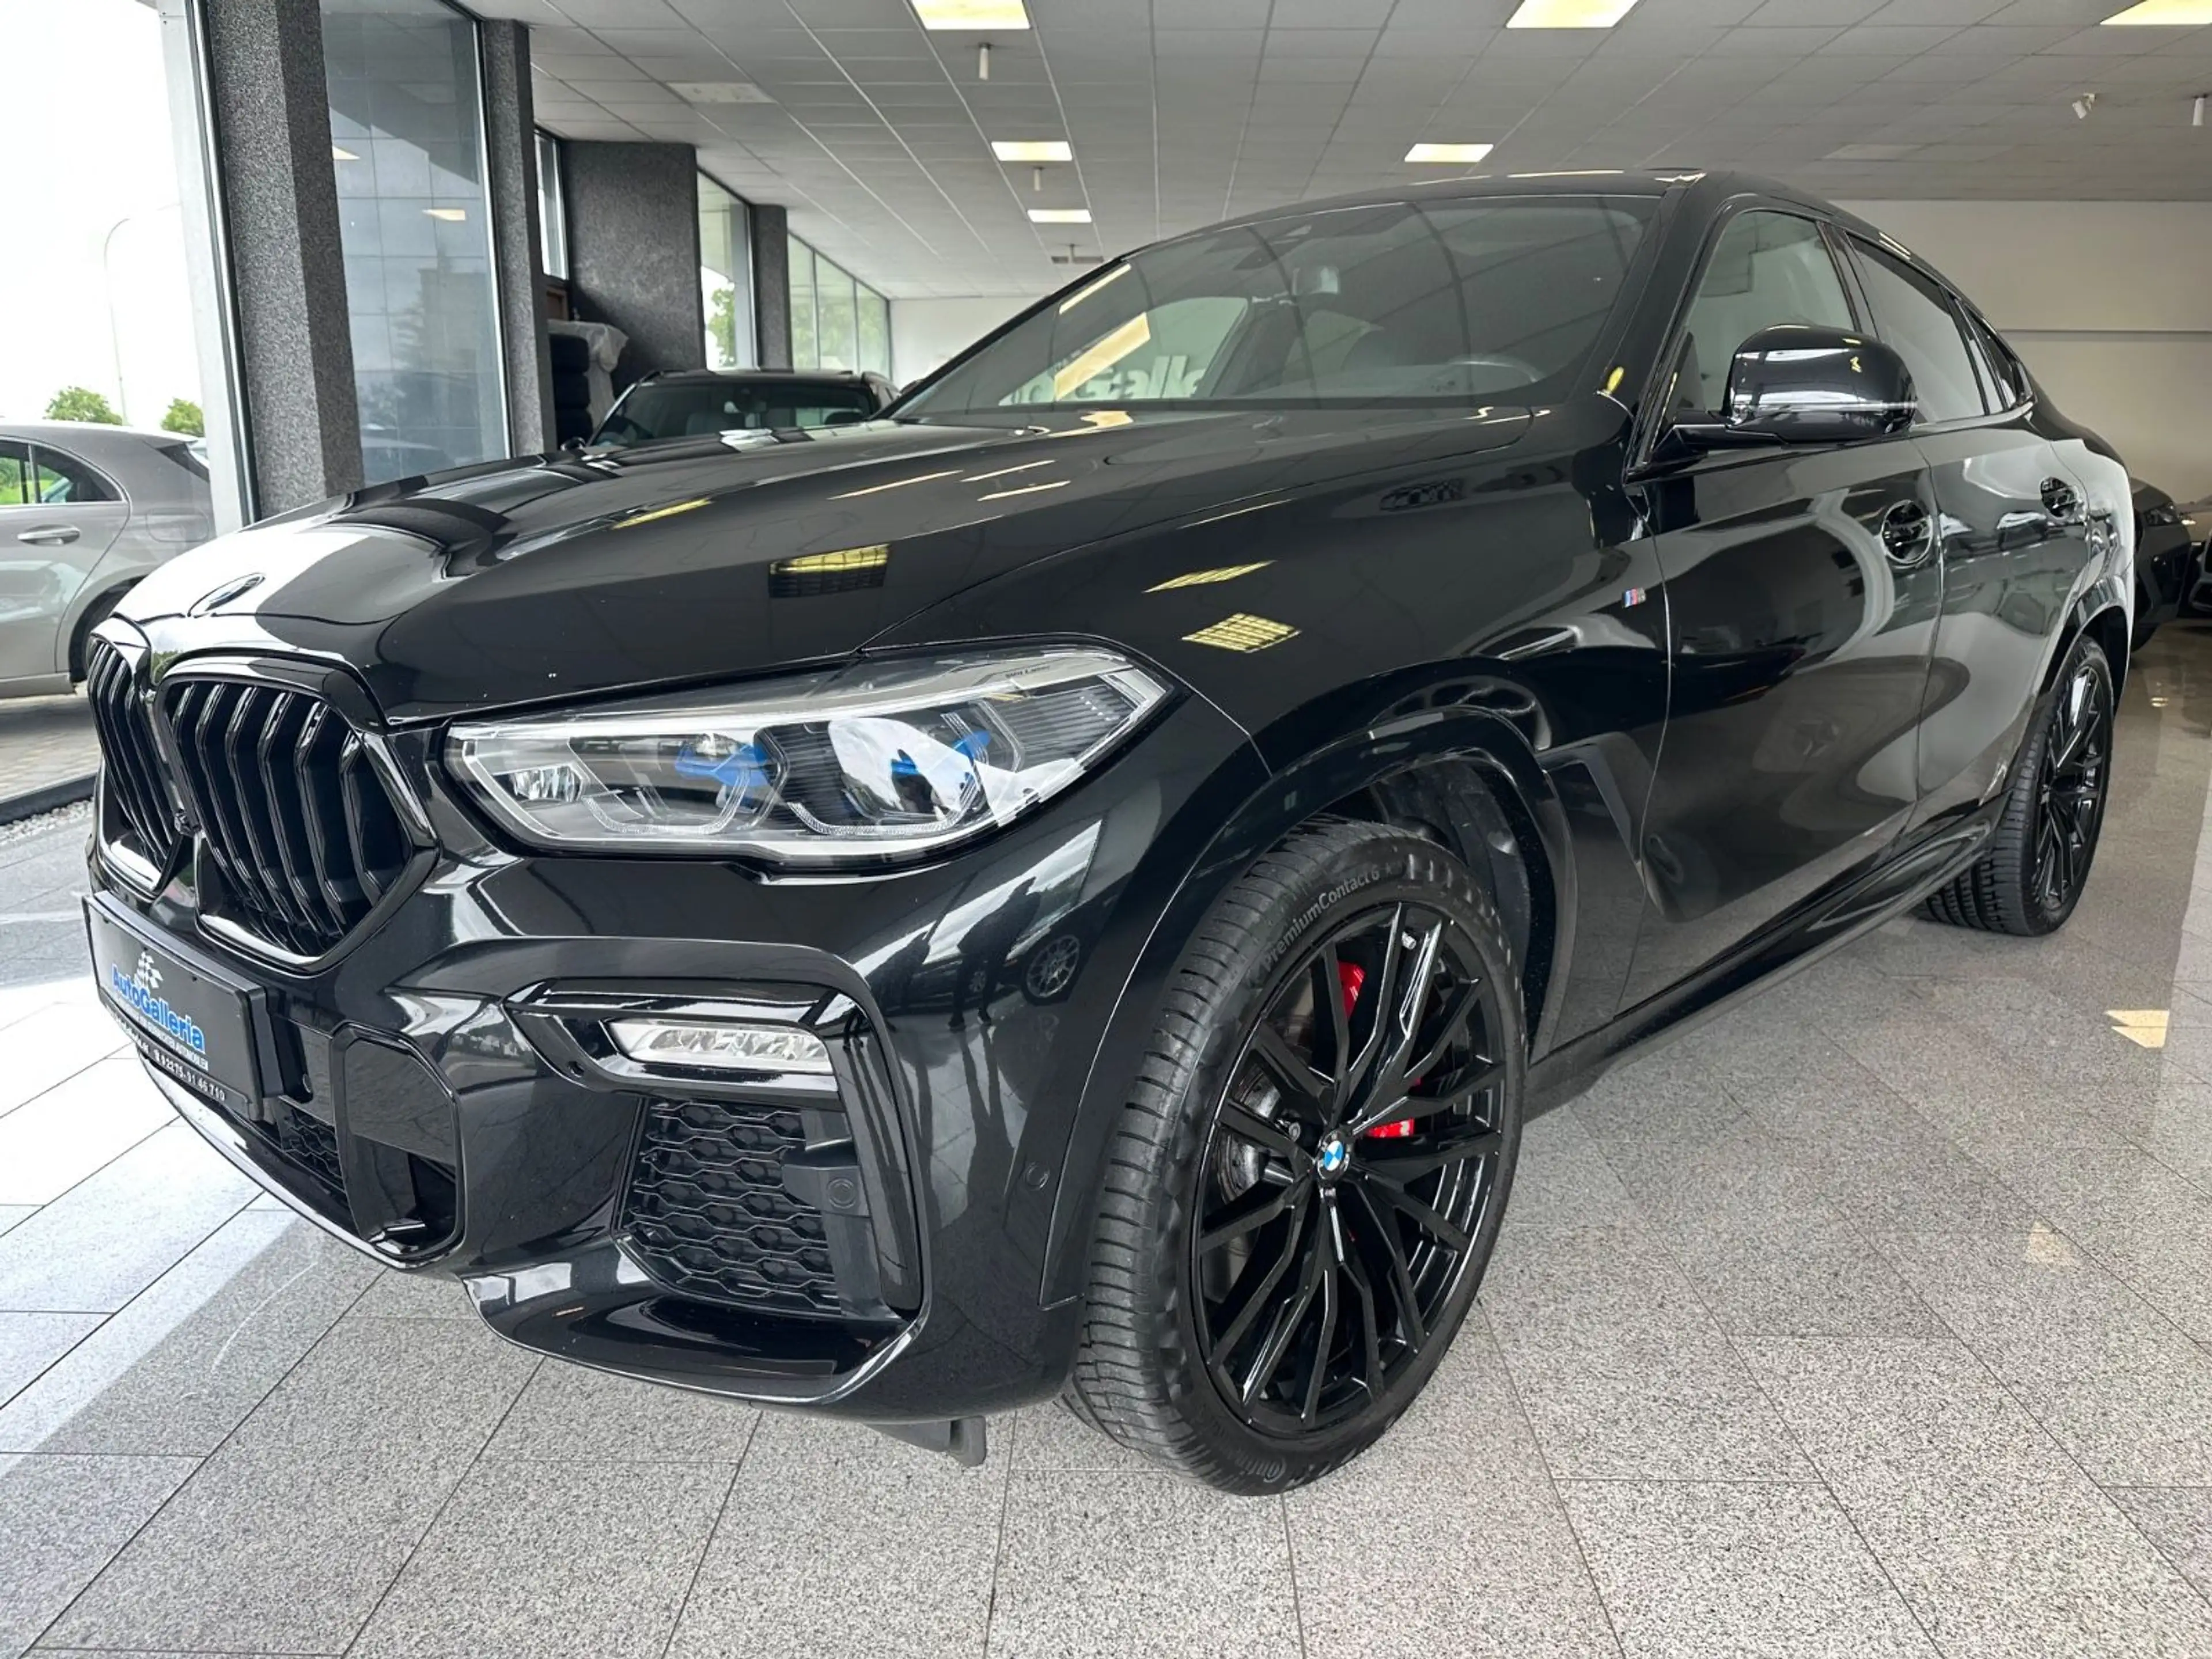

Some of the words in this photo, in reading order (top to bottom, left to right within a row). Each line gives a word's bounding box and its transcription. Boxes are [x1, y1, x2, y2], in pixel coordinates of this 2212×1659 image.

[1261, 873, 1370, 972] PremiumContact
[1370, 864, 1380, 881] 6
[112, 963, 205, 1054] AutoGalleria
